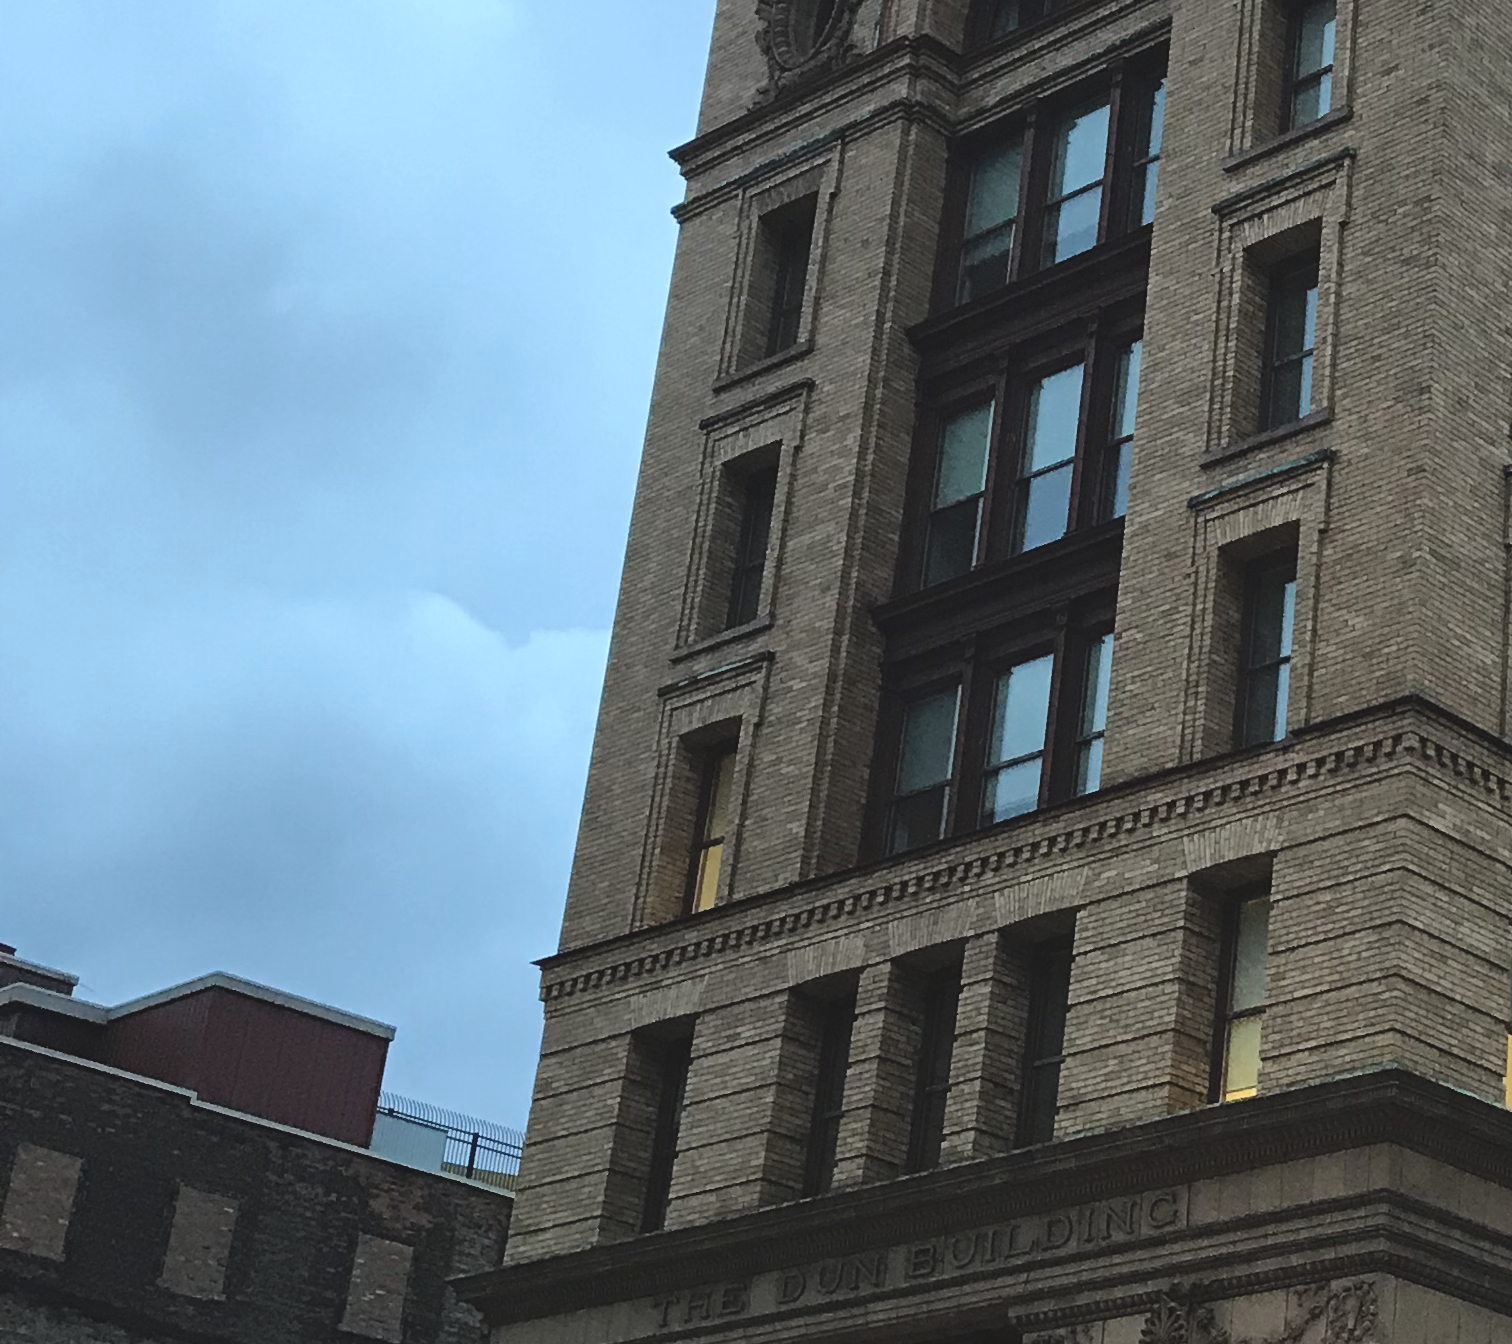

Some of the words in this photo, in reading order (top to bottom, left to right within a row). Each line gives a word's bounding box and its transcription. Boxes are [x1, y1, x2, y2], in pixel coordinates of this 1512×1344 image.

[653, 1284, 748, 1328] THE
[777, 1255, 888, 1305] DUN
[905, 1193, 1179, 1279] BUILDING
